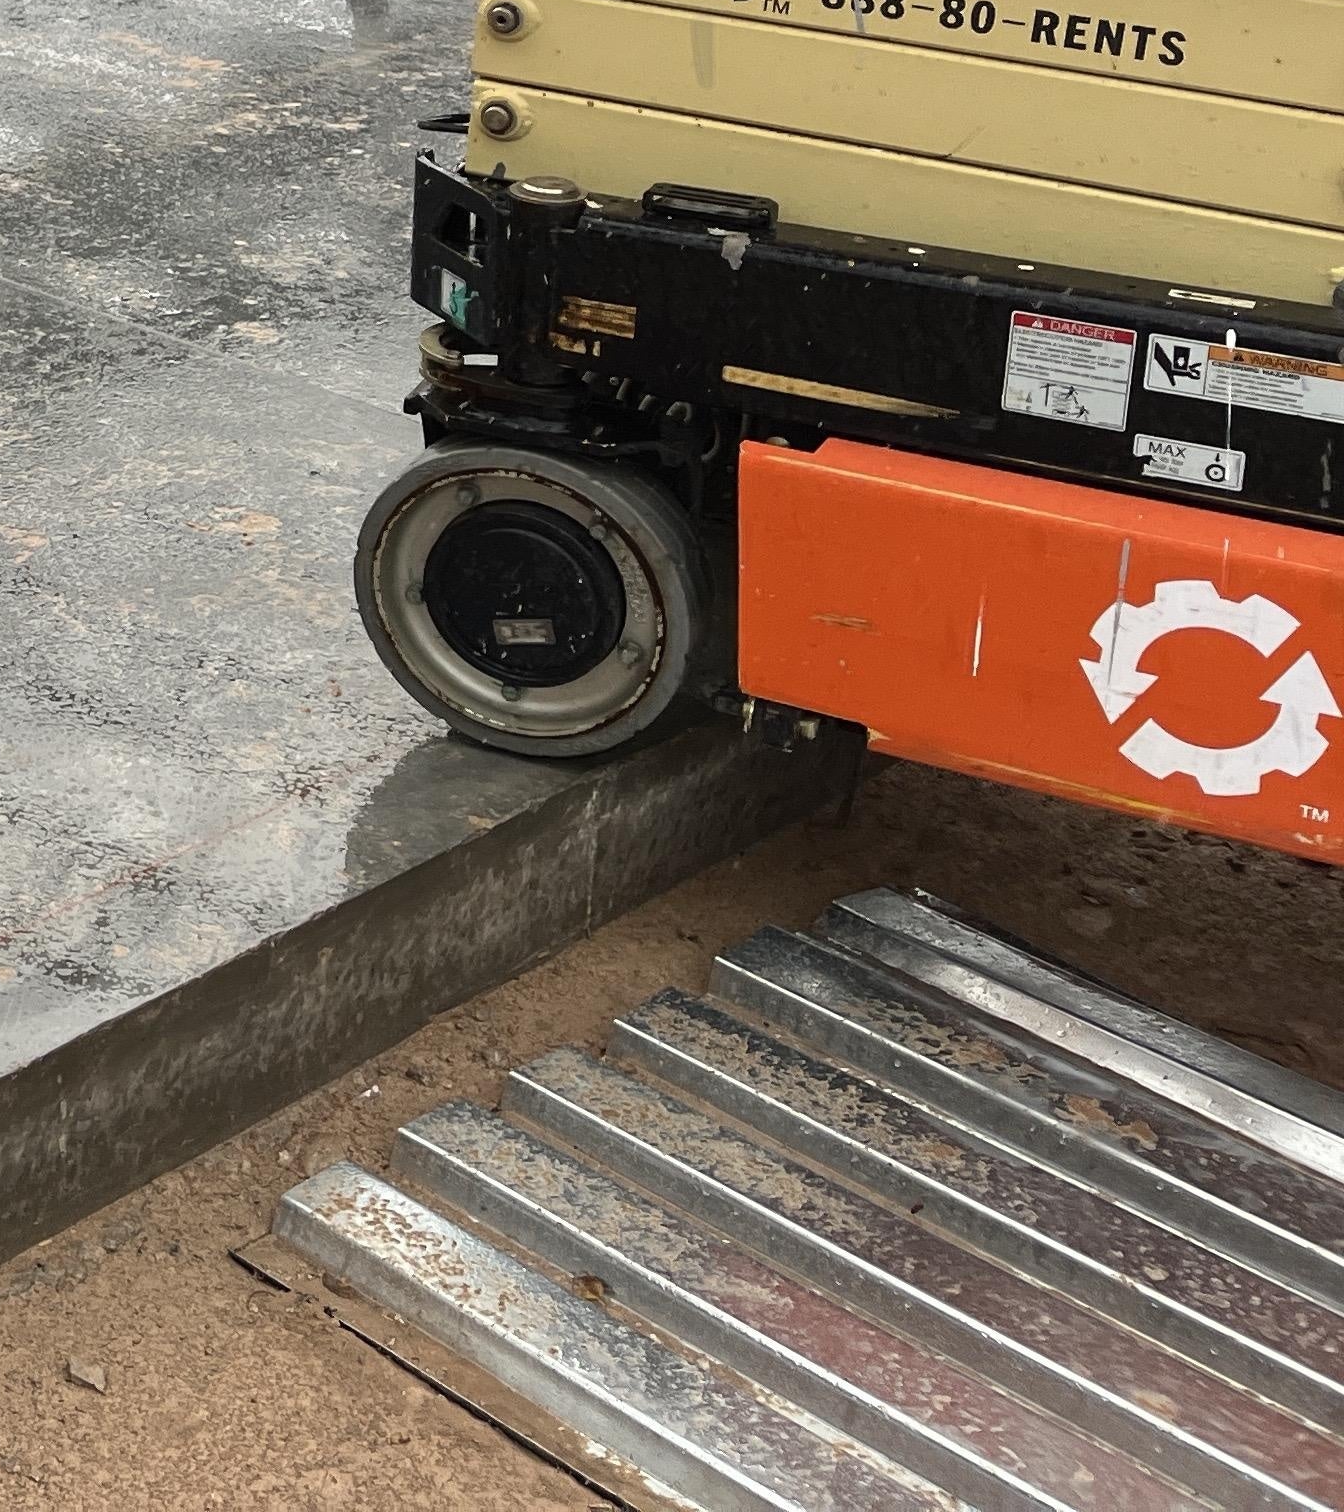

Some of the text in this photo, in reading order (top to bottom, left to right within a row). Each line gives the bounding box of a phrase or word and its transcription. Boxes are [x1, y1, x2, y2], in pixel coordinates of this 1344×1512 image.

[1049, 319, 1116, 341] DANGER
[1248, 353, 1329, 377] WARNING
[1147, 441, 1188, 459] MAX
[1298, 803, 1330, 824] TM
